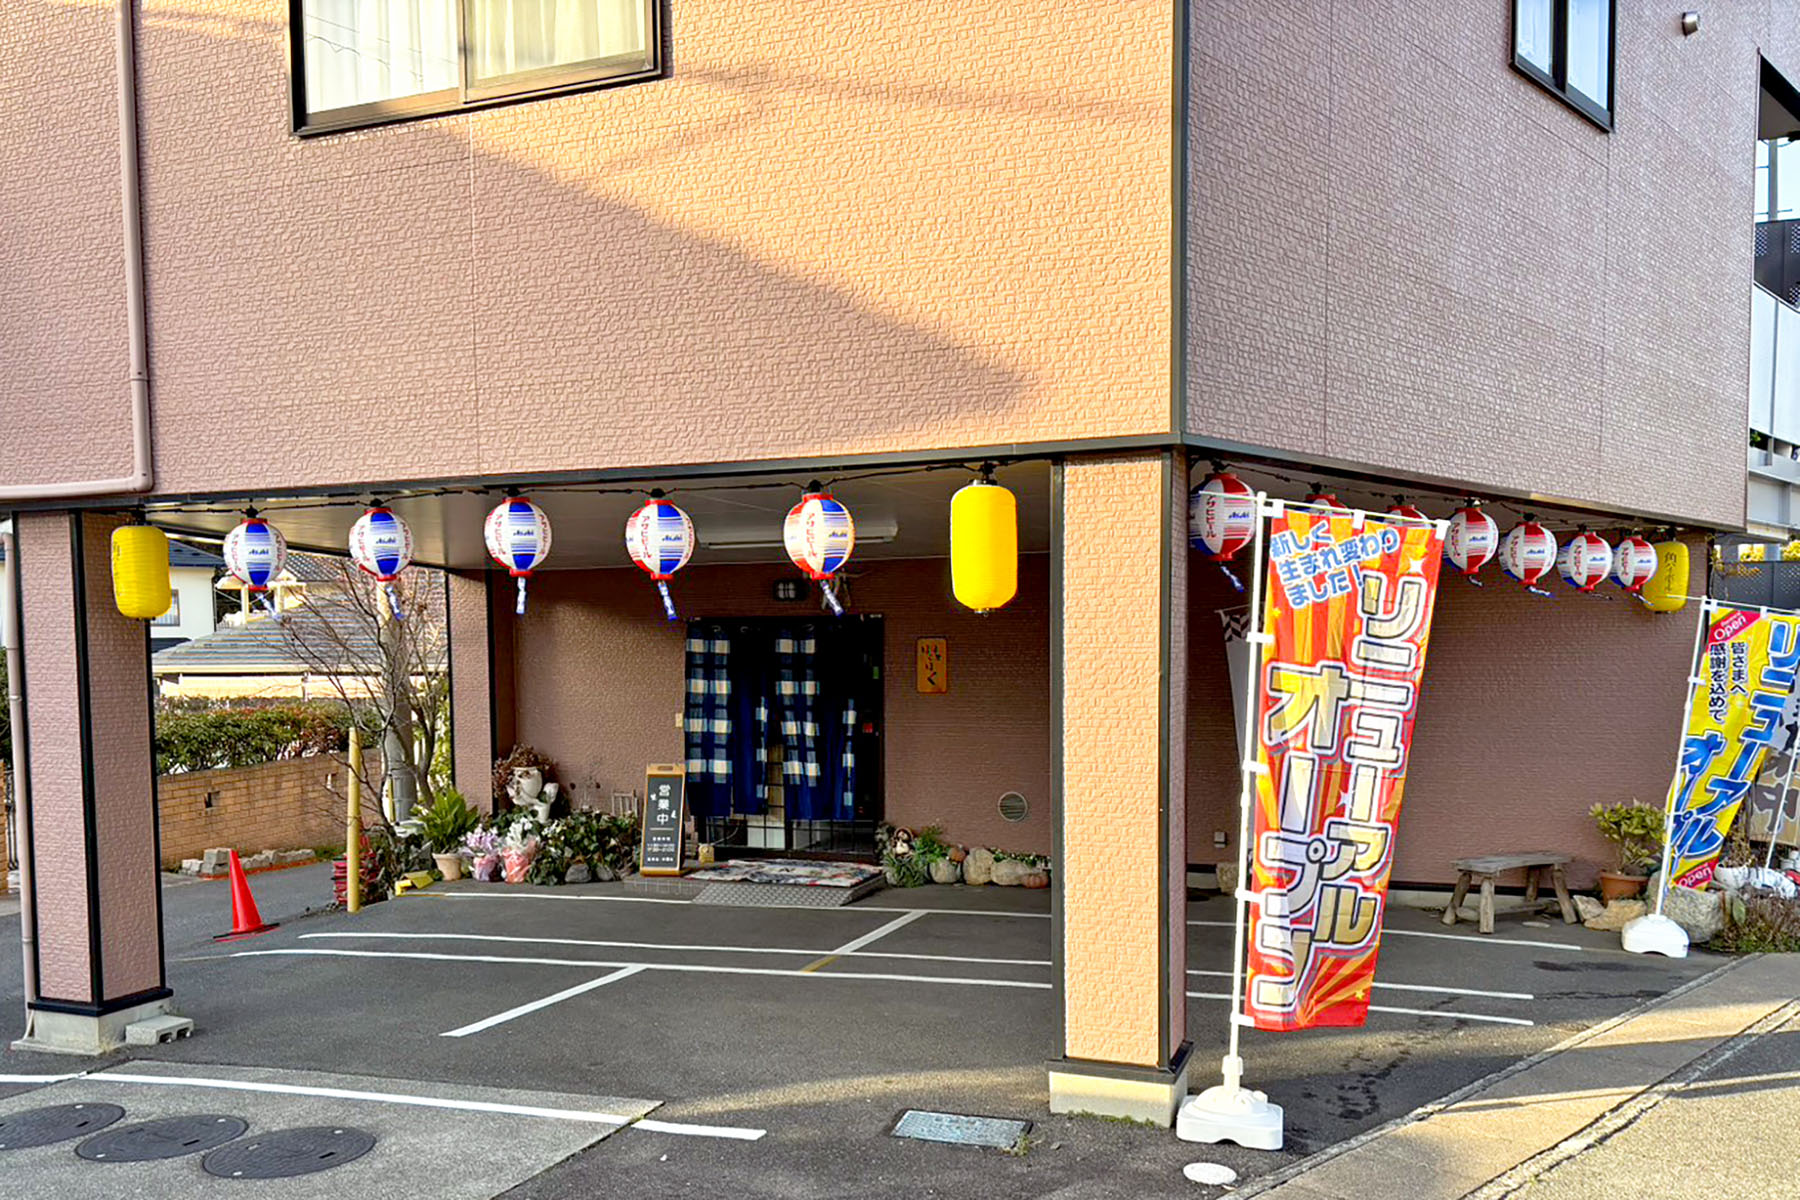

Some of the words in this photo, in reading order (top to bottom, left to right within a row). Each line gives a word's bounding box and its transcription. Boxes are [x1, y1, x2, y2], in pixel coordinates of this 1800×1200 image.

[1271, 522, 1333, 558] 新しく
[1279, 528, 1399, 583] 生まれ変わり
[1286, 563, 1363, 607] ました!
[1713, 613, 1748, 641] Open
[1707, 642, 1728, 723] 感謝を込めて
[1730, 642, 1748, 695] 皆さまへ
[1314, 572, 1424, 946] リニューアル
[657, 784, 671, 826] 営業中
